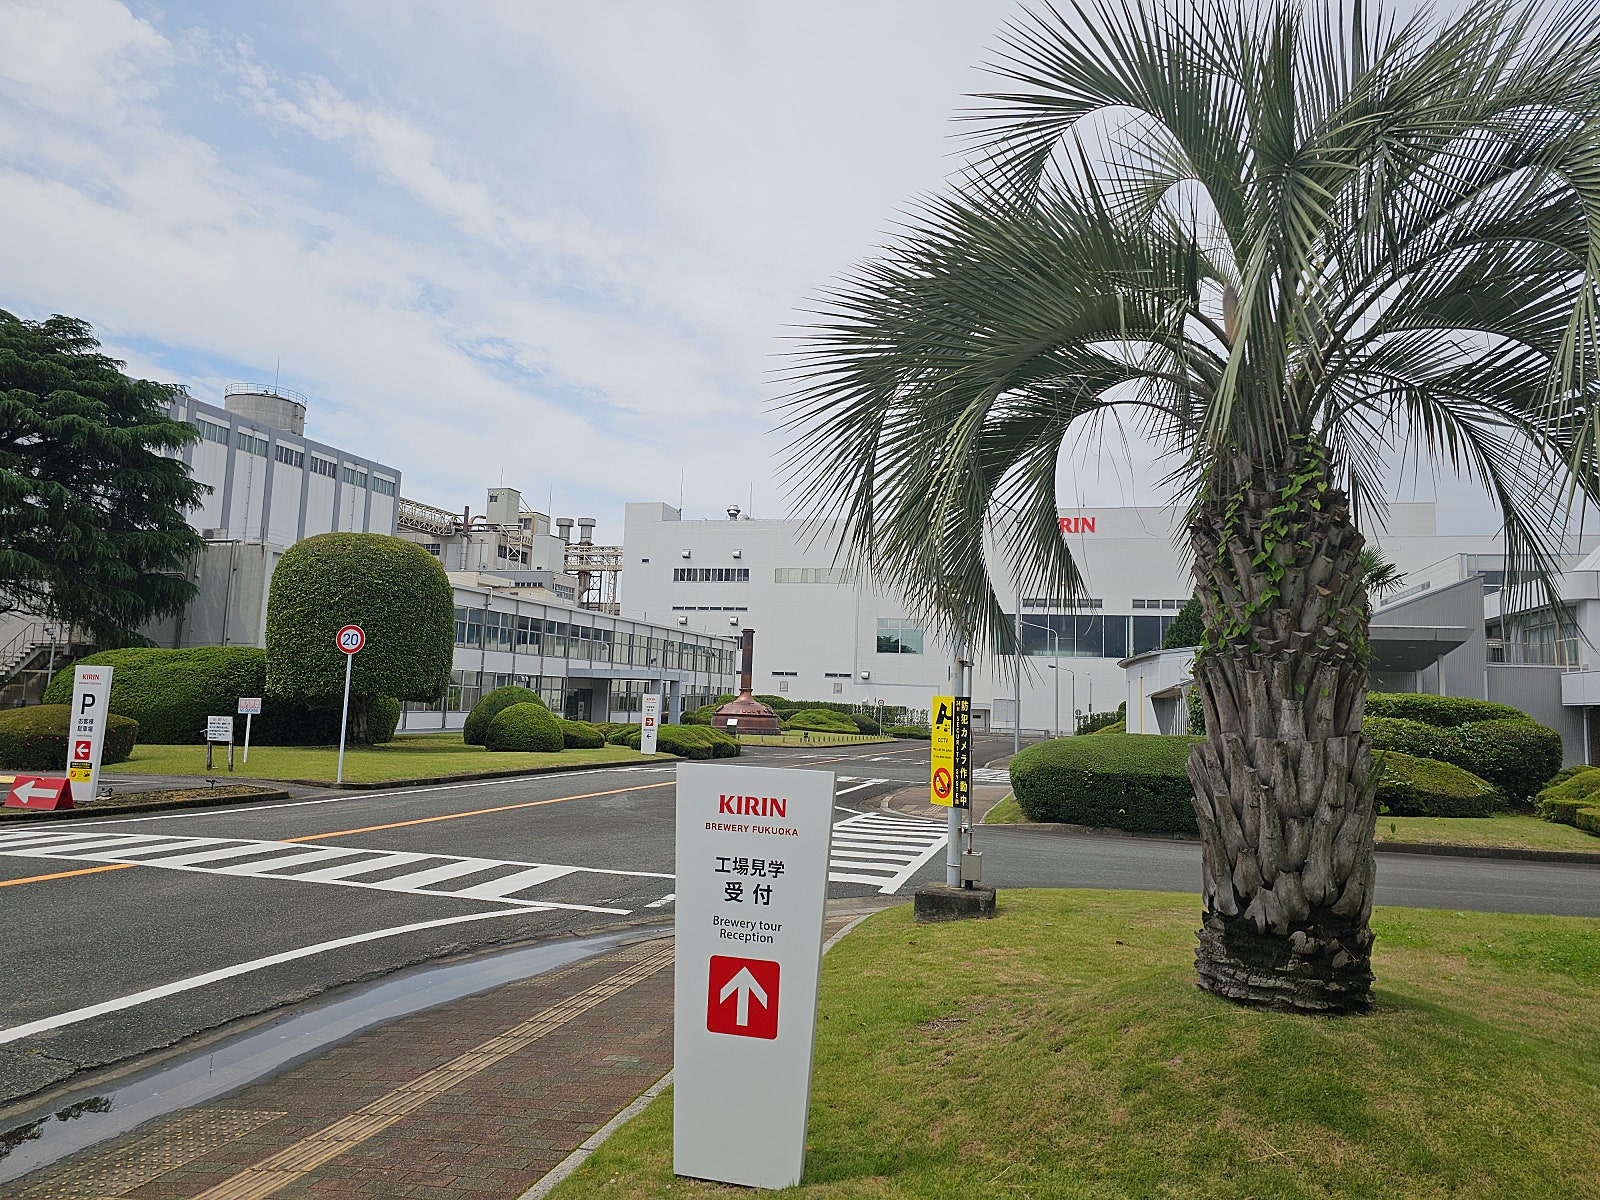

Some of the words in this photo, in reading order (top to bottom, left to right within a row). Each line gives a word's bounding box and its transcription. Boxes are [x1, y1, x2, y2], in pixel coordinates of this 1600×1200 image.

[1059, 517, 1095, 533] RIN
[342, 633, 359, 646] 20
[81, 693, 96, 715] P
[960, 700, 969, 807] 防犯カメラ作動中
[719, 794, 787, 818] KIRIN
[705, 822, 749, 833] BREWERY
[752, 825, 799, 837] FUKUOKA
[715, 856, 785, 879] 工場見学
[713, 915, 757, 932] Brewery
[759, 920, 782, 932] tour
[719, 928, 774, 944] Reception
